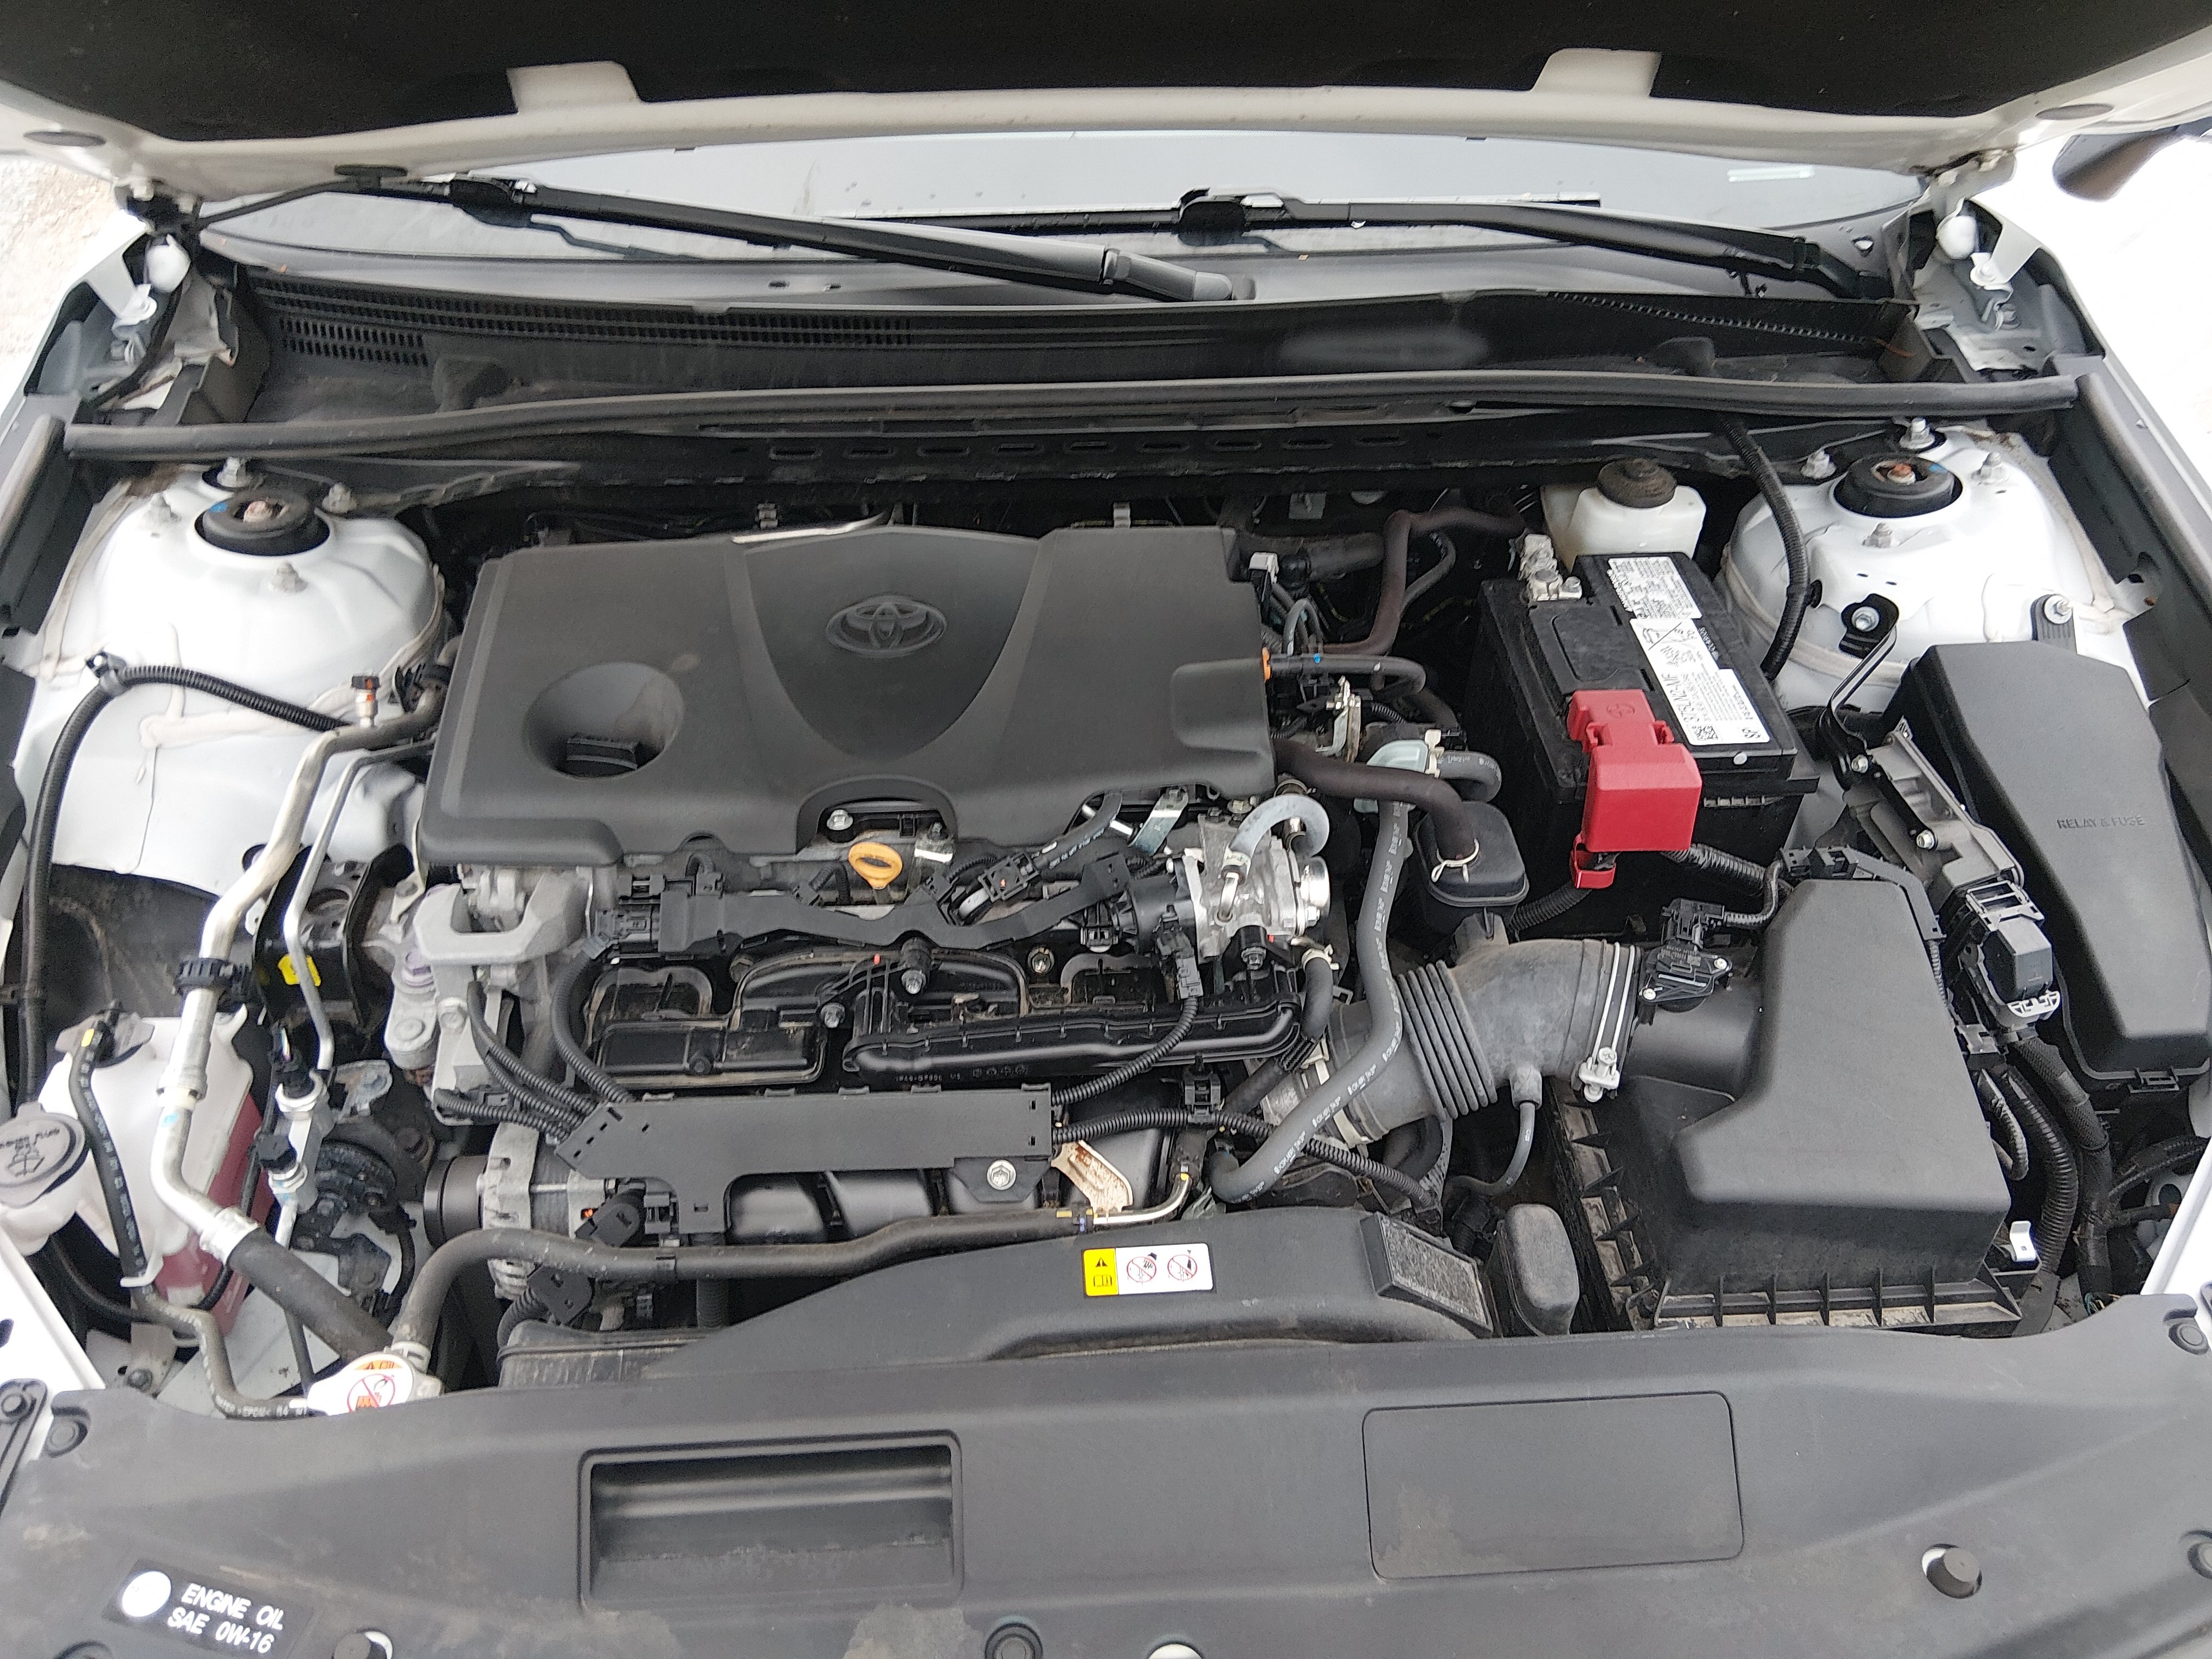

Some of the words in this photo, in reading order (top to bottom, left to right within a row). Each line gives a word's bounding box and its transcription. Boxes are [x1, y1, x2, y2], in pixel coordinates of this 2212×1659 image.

[2057, 818, 2098, 829] RELAY
[2100, 818, 2110, 827] &
[2112, 815, 2145, 827] FUSE
[166, 1606, 211, 1635] SAE
[215, 1621, 275, 1654] 0W-16
[181, 1583, 251, 1619] ENGINE
[255, 1605, 285, 1631] OIL
